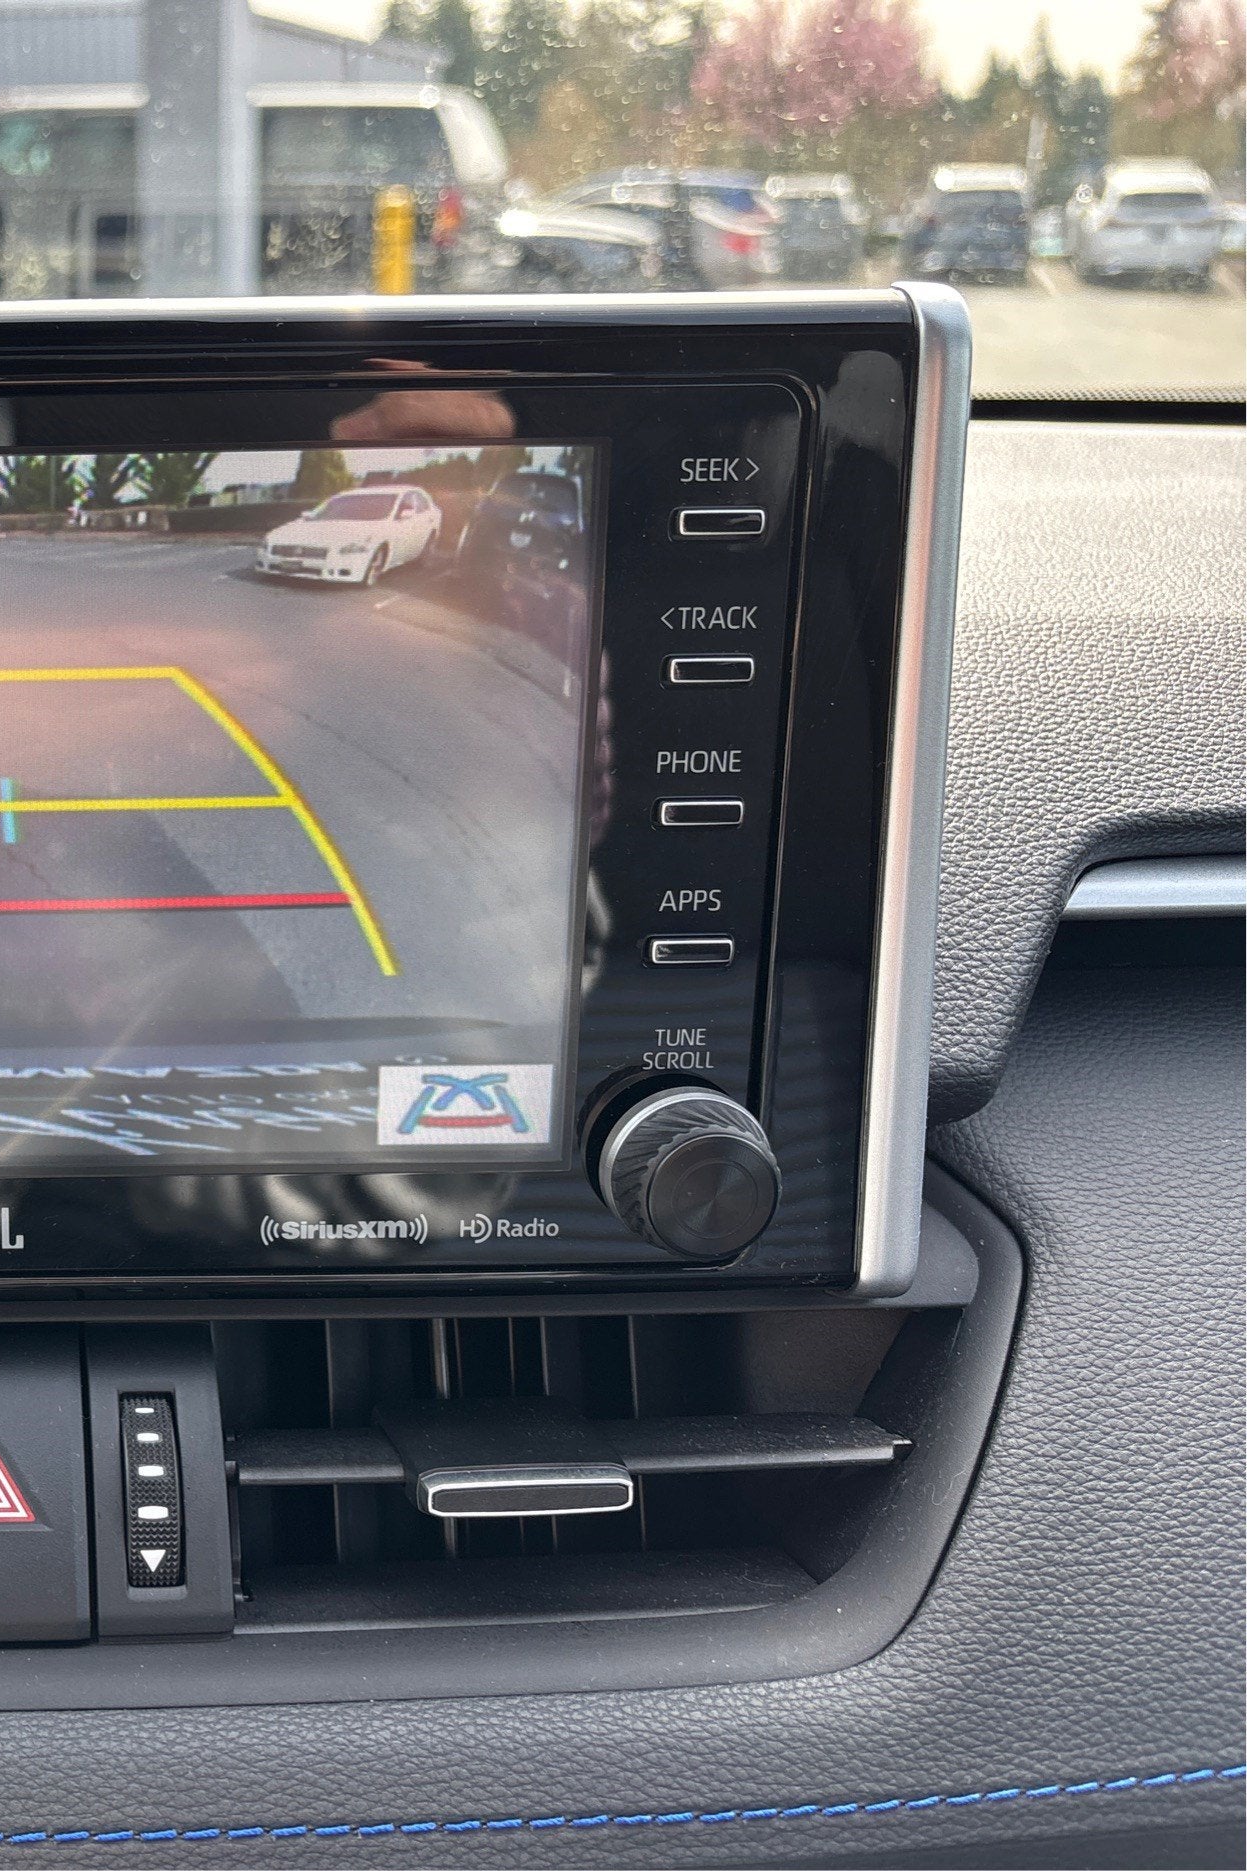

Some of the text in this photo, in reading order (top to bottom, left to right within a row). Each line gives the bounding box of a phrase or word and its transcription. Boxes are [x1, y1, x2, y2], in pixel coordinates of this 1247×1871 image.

[656, 750, 742, 774] PHONE
[659, 889, 721, 912] APPS
[654, 1028, 707, 1046] TUNE
[642, 1051, 714, 1070] SCROLL
[497, 1217, 560, 1239] Radio
